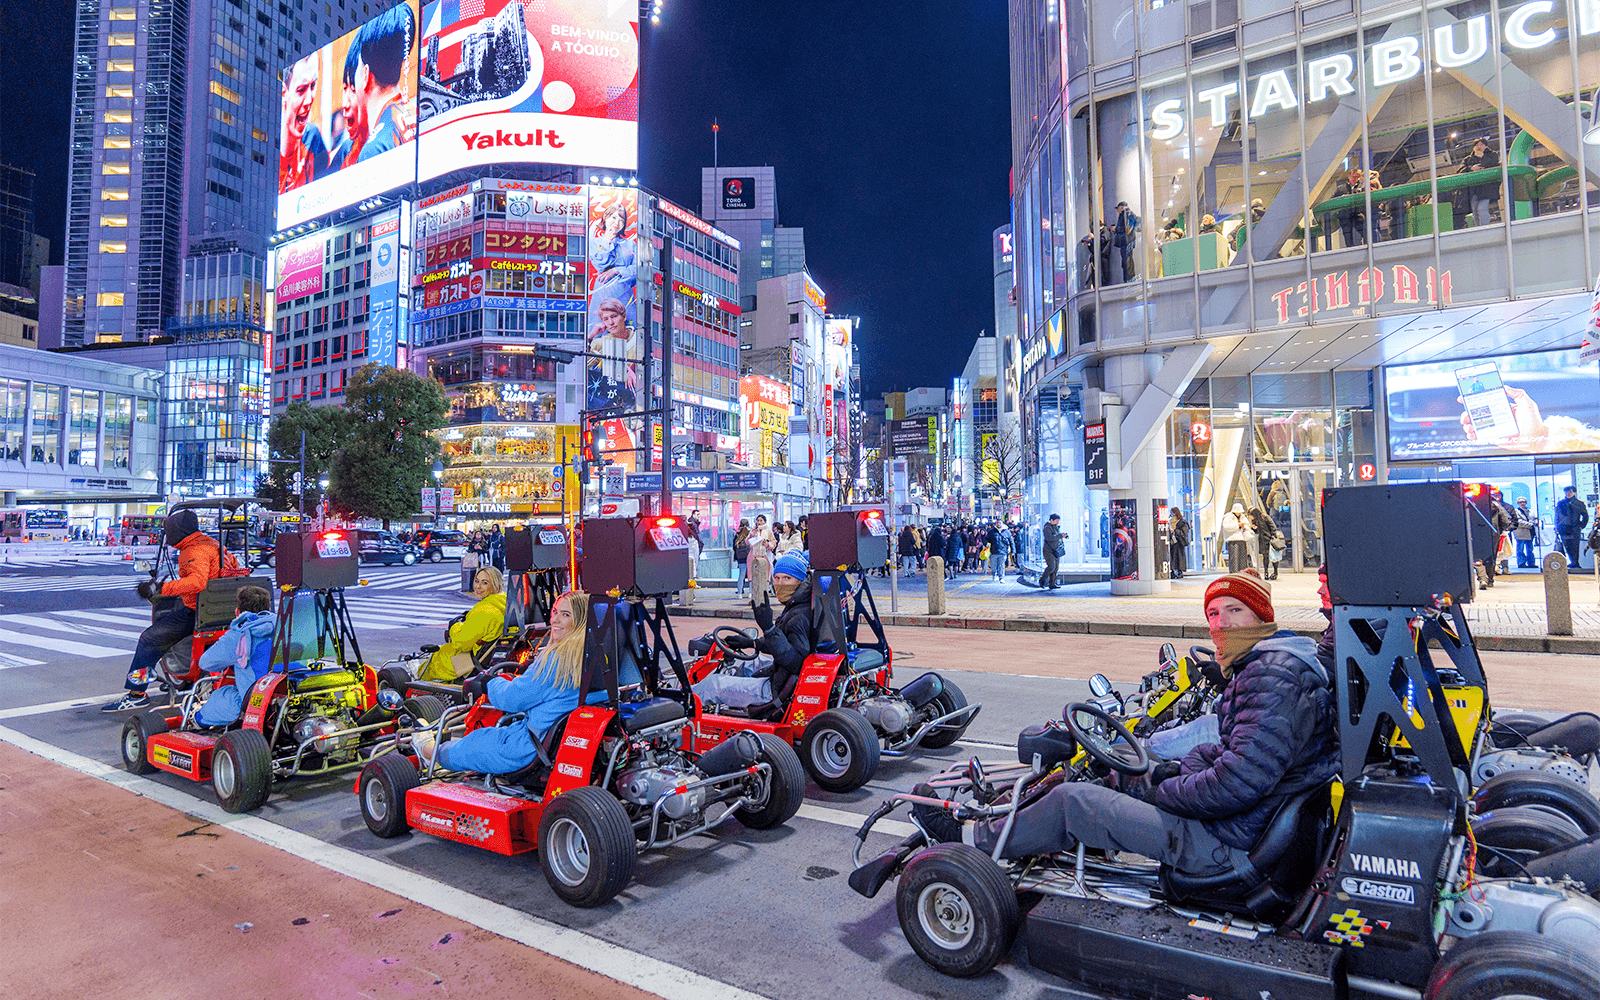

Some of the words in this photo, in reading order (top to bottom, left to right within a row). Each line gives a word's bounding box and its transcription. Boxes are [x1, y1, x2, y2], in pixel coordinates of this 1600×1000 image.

[551, 24, 630, 44] BEM-VINDO
[551, 41, 562, 53] A
[565, 38, 620, 58] TÓQUIO
[462, 129, 565, 151] Yakult
[534, 200, 584, 218] しゃぶ葉
[486, 233, 565, 251] コンタクト
[450, 261, 474, 279] ガスト
[539, 260, 577, 276] ガスト
[439, 282, 467, 304] ガスト
[372, 301, 384, 363] アイシ
[384, 299, 394, 366] コンタク
[1086, 425, 1105, 438] MARVEL
[1089, 469, 1104, 480] B1F
[1350, 852, 1421, 879] YAMAHA
[1358, 880, 1412, 901] Castrol
